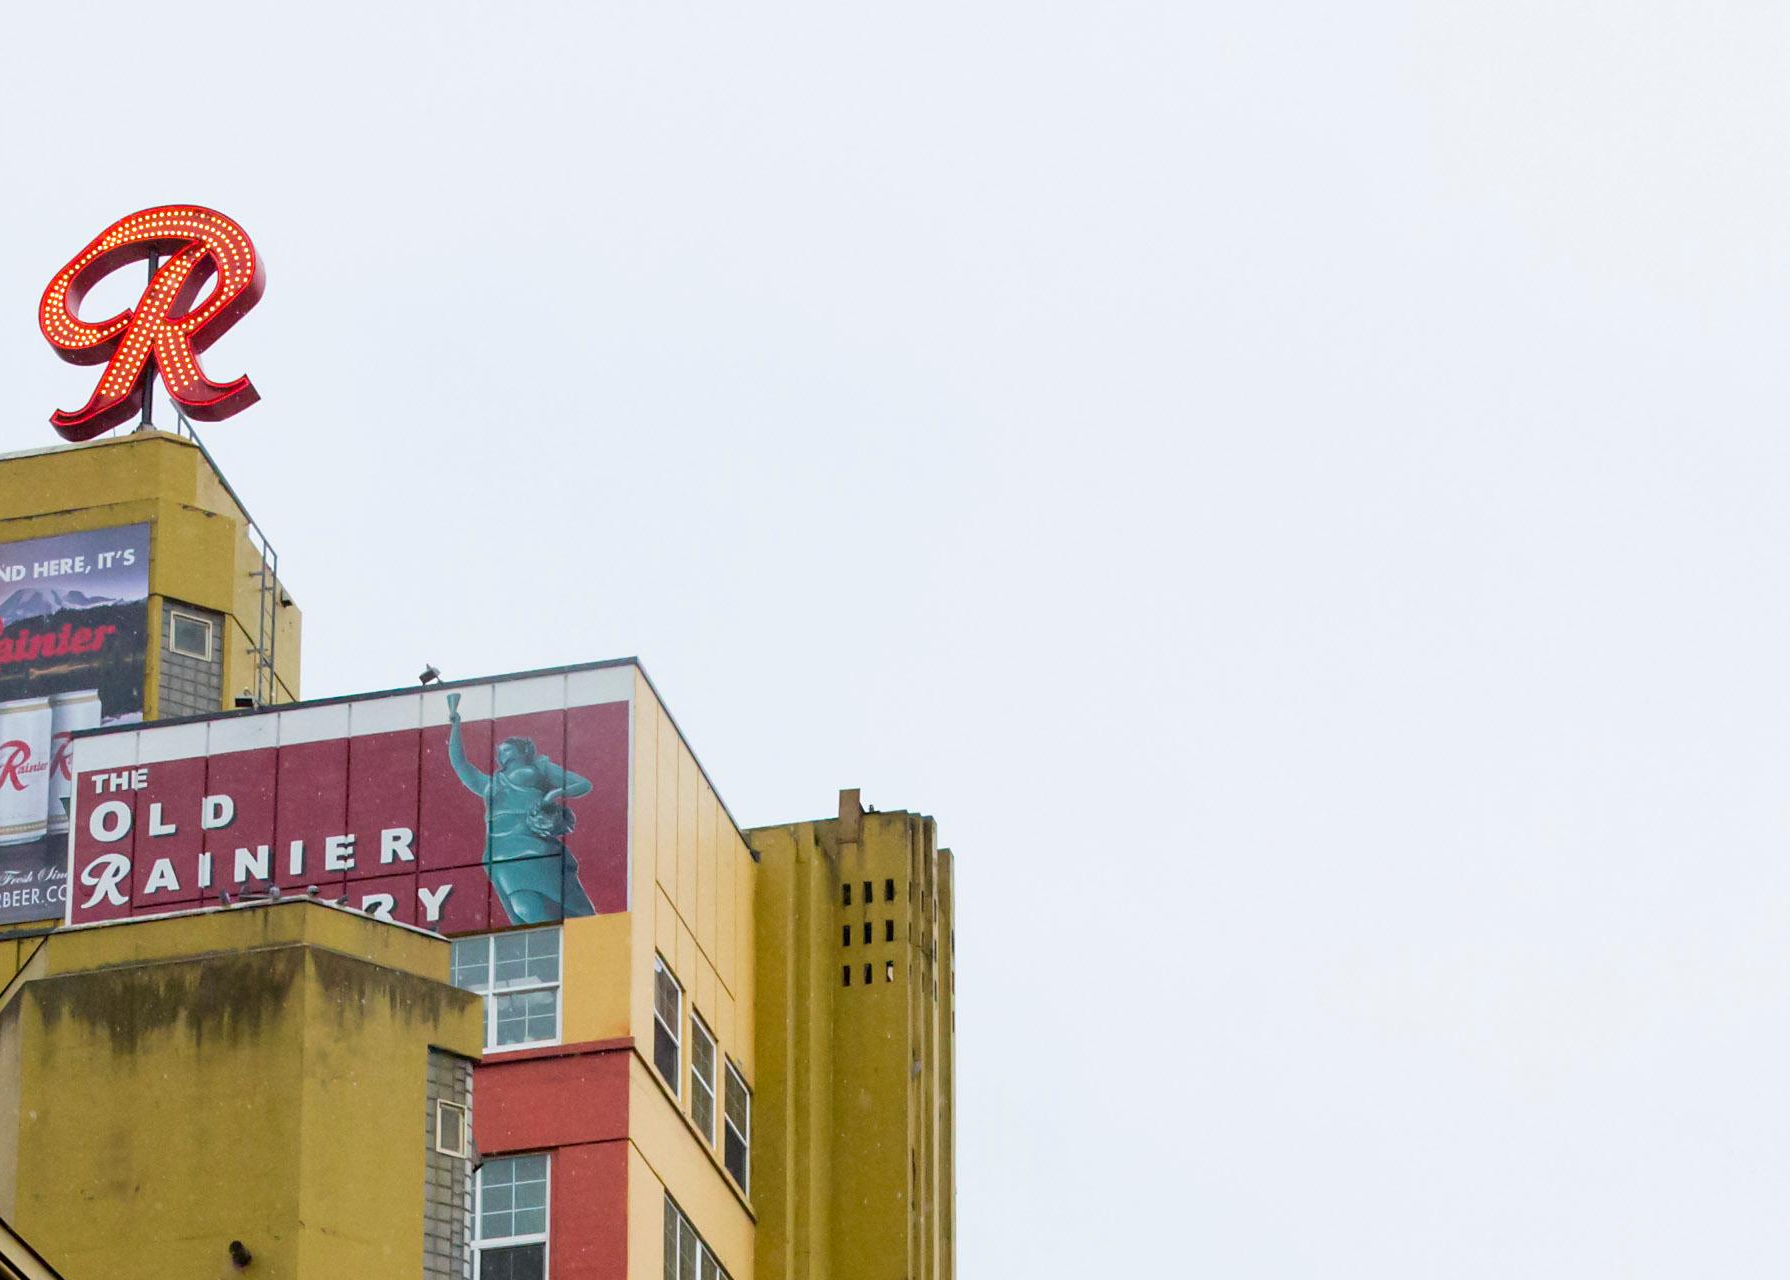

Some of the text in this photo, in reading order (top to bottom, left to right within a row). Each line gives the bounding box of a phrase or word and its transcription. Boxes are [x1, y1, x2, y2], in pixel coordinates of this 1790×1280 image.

[38, 204, 266, 443] R
[34, 556, 92, 579] HERE,
[98, 548, 135, 569] IT'S
[91, 768, 149, 794] THE
[89, 794, 235, 843] OLD
[80, 827, 416, 909] RAINIER
